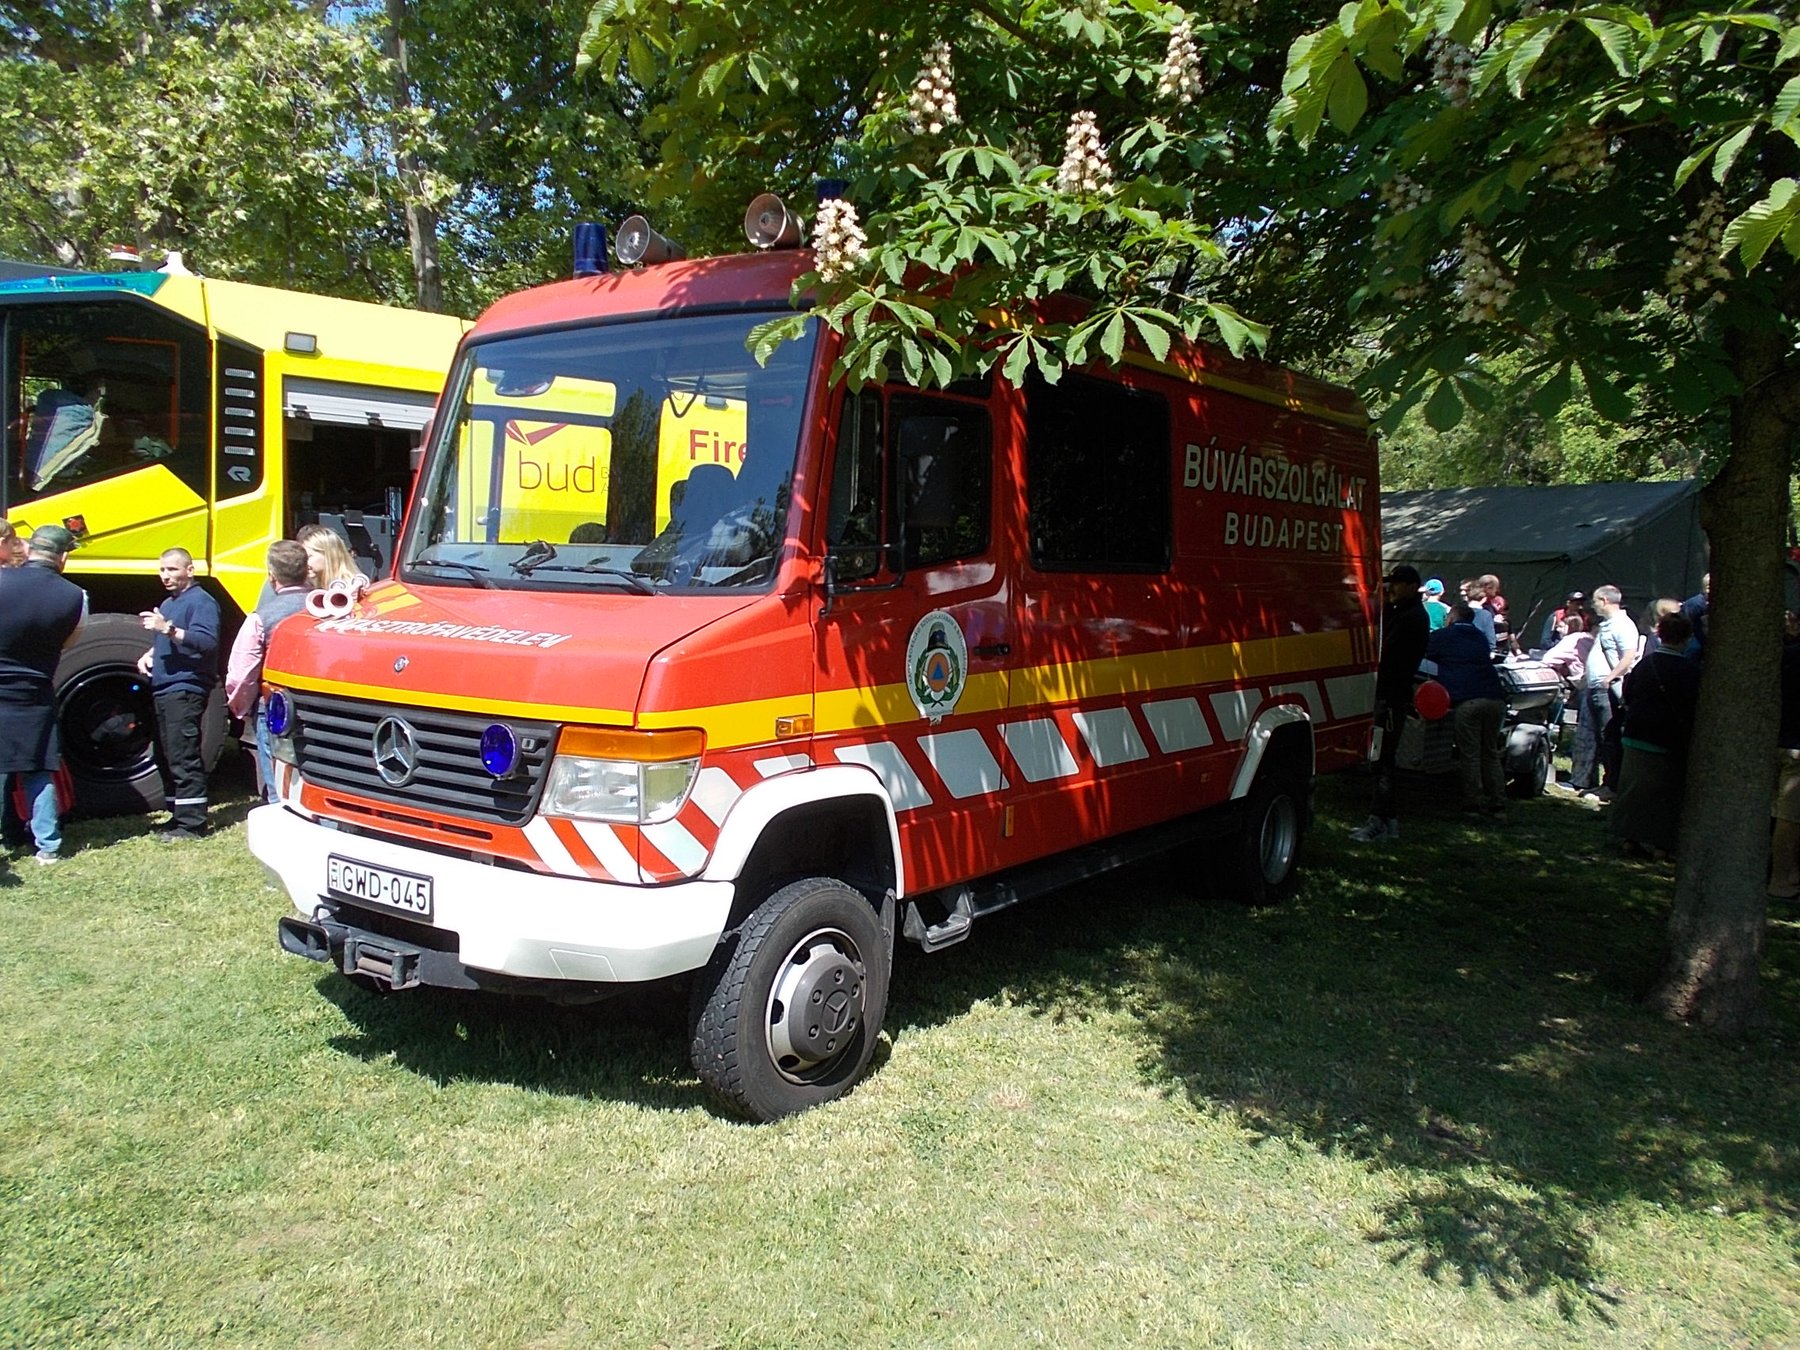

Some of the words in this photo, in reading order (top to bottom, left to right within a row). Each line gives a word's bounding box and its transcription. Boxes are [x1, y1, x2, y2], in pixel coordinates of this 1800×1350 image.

[519, 450, 595, 493] bud
[1183, 436, 1367, 512] BÚVÁRSZOLGÁLAT
[1224, 512, 1343, 553] BUDAPEST
[342, 865, 426, 911] GWD-045
